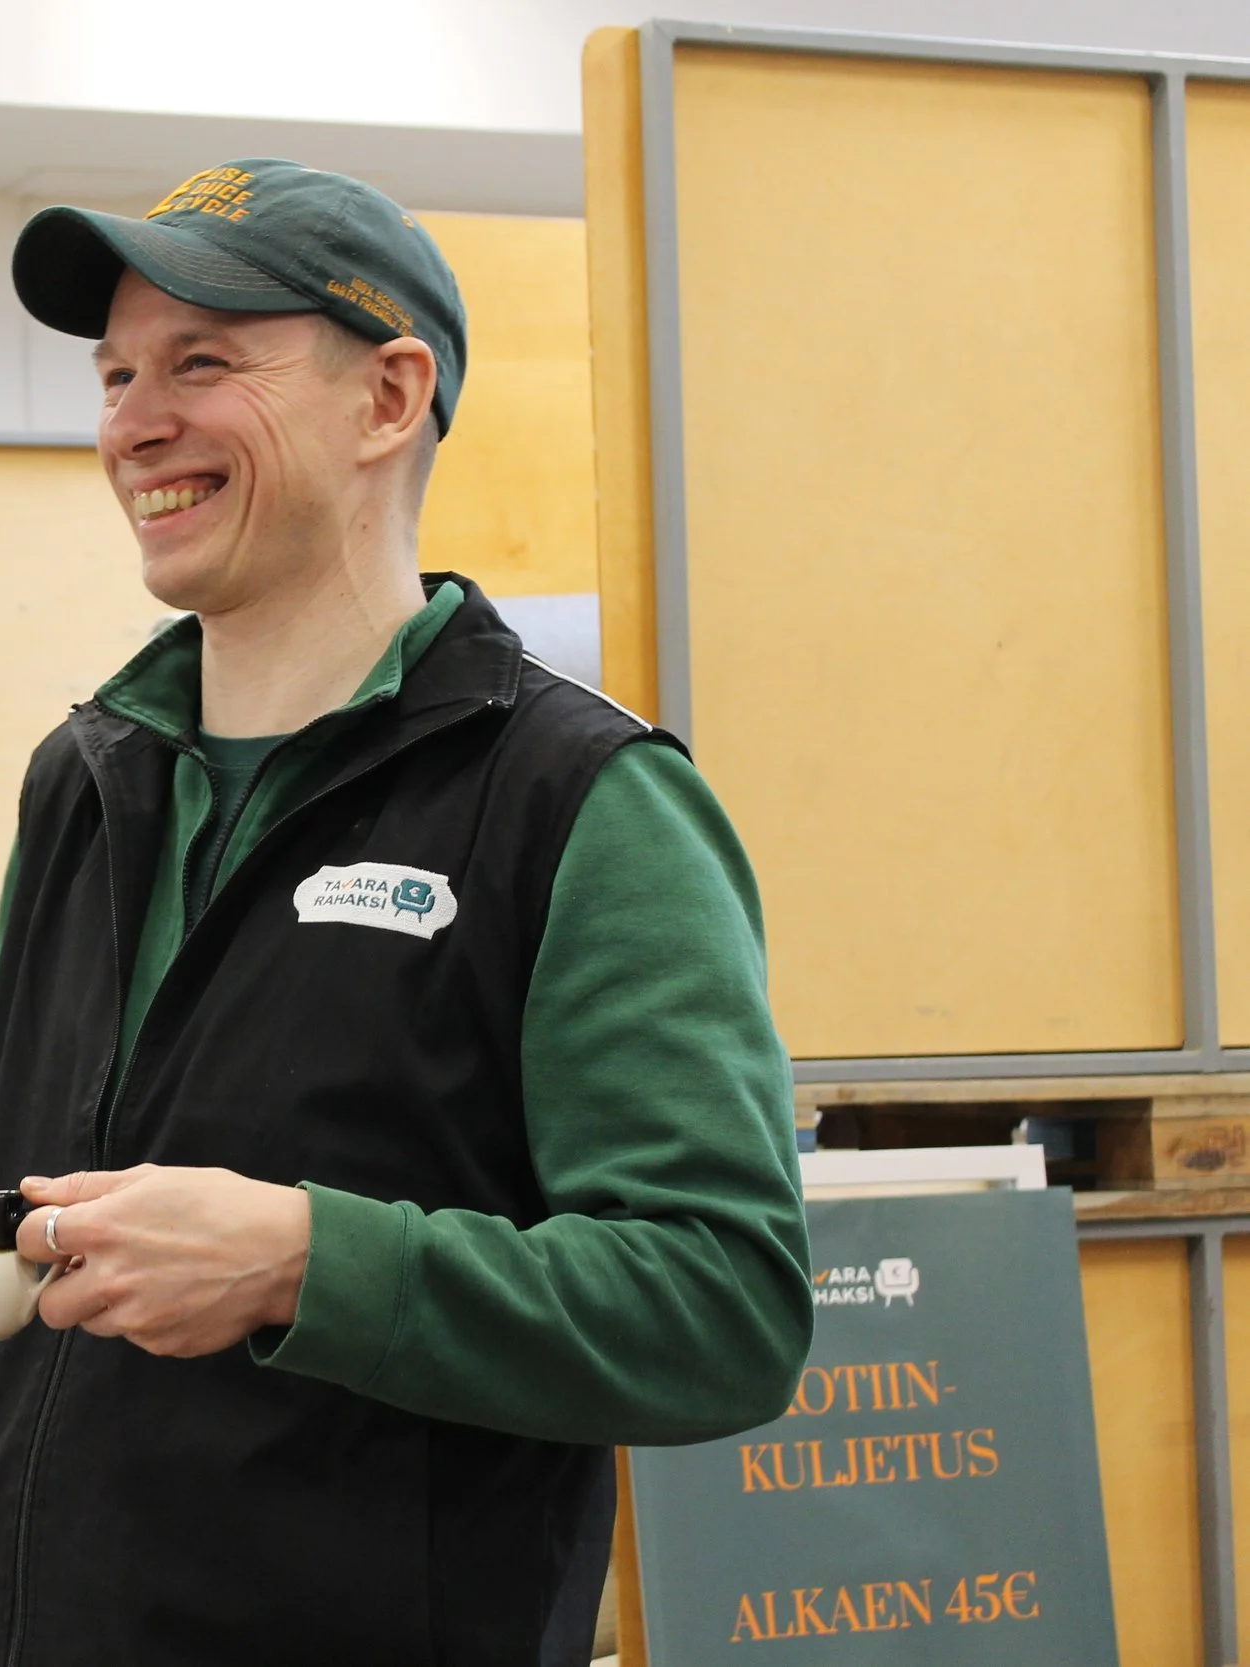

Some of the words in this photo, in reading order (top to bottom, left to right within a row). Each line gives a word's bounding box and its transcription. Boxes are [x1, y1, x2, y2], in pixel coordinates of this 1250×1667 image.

[313, 893, 388, 911] RAHAKSI
[813, 1285, 875, 1305] HAKSI
[786, 1361, 957, 1417] OTIIN-
[738, 1428, 1000, 1494] KULJETUS
[729, 1579, 933, 1644] ALKAEN
[943, 1570, 1041, 1625] 45€
